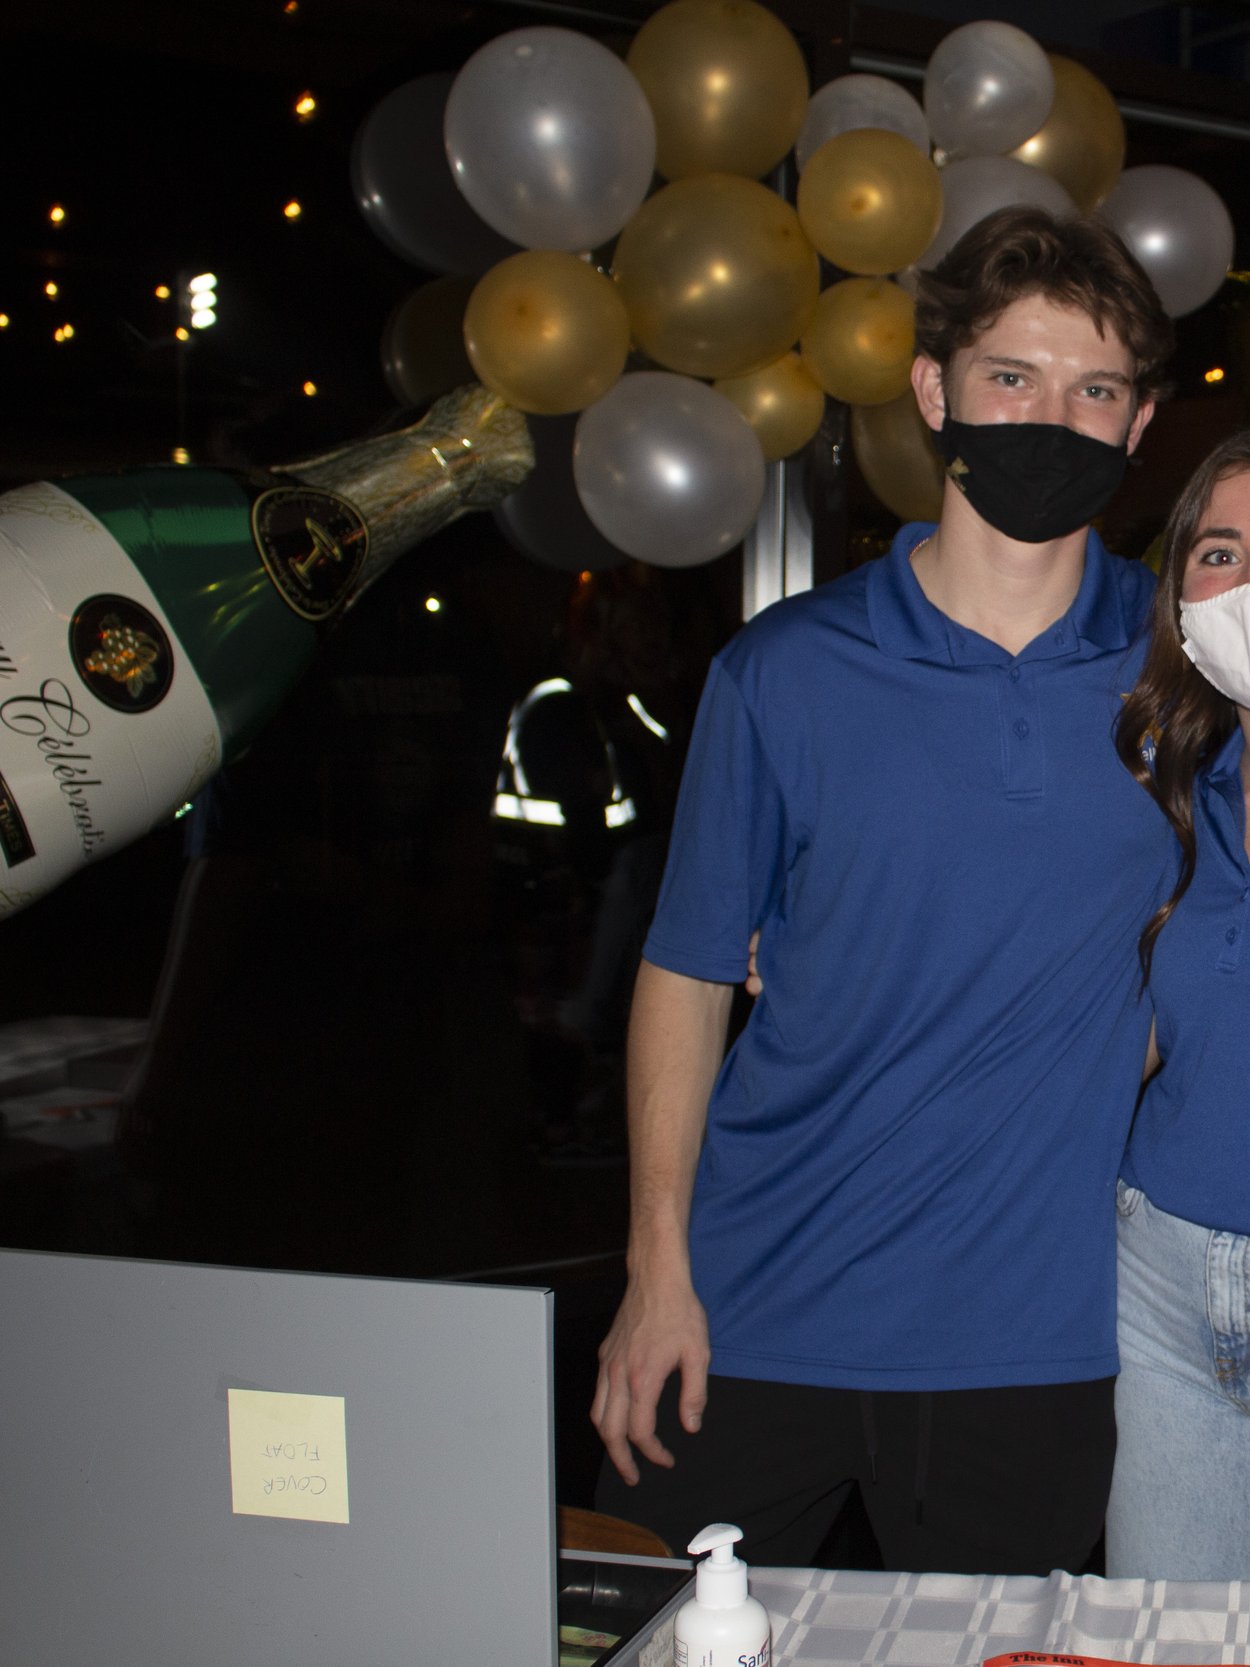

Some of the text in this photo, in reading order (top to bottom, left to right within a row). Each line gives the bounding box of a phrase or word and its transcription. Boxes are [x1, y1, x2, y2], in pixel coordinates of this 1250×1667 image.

[261, 1442, 320, 1461] FLOAT
[263, 1475, 327, 1495] COVER
[1009, 1654, 1085, 1666] The Inn
